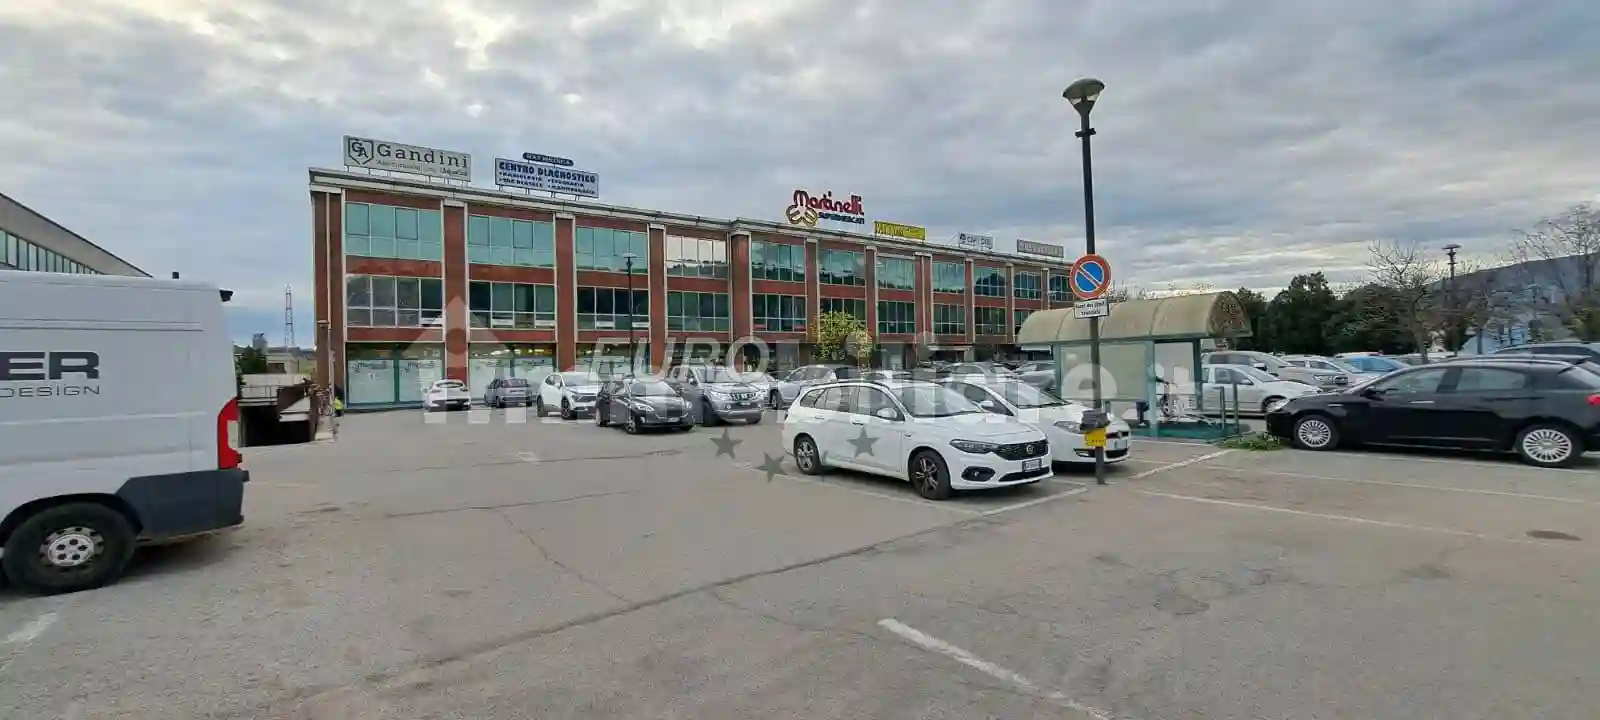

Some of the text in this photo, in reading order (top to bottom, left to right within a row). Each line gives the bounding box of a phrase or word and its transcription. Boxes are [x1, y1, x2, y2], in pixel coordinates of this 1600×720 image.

[377, 143, 468, 168] Gandini
[499, 161, 596, 184] CENTRO DIAGNOSTICO
[793, 189, 865, 216] Martinelli
[0, 351, 99, 380] ER
[0, 385, 100, 398] DESIGN
